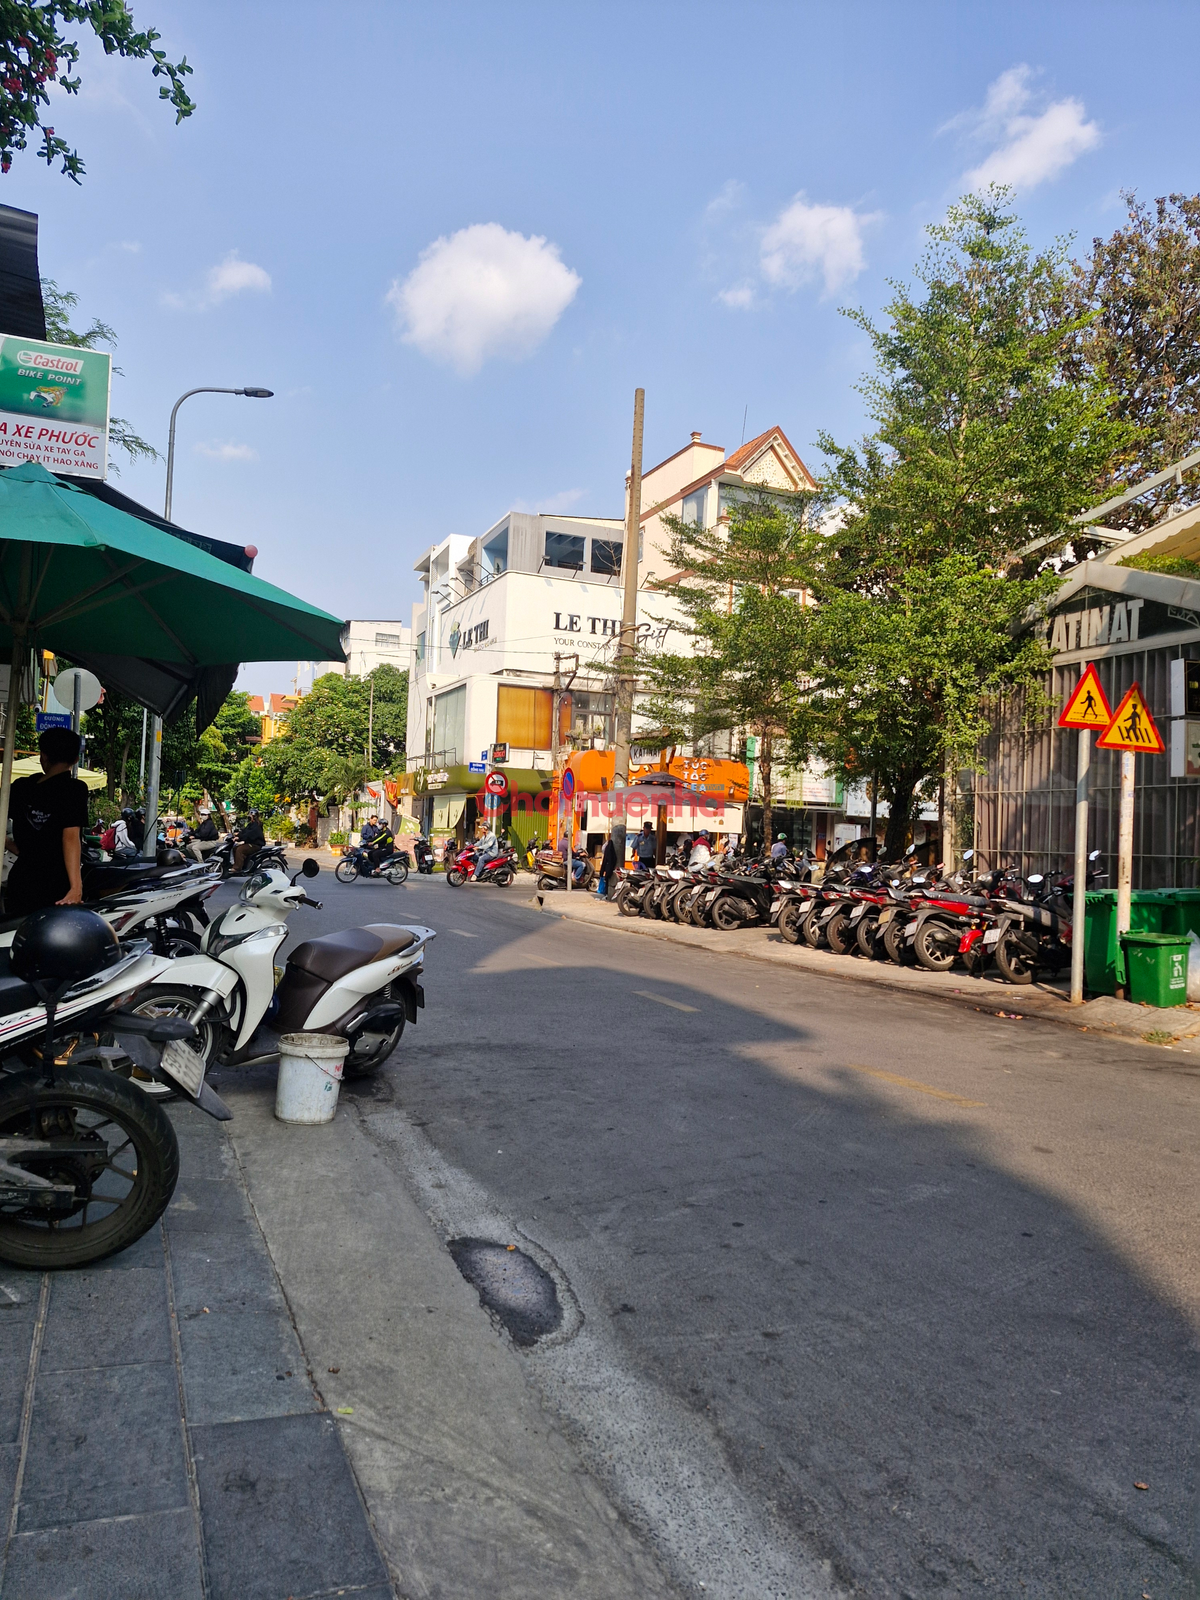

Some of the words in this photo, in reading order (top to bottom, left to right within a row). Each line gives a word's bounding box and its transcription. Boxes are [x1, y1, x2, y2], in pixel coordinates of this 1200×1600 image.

[33, 354, 79, 373] Castrol
[17, 369, 44, 380] BIKE
[47, 374, 82, 386] POINT
[12, 424, 35, 439] XE
[37, 428, 99, 449] PHƯỚC
[24, 441, 41, 451] SỬA
[44, 445, 54, 453] XE
[56, 446, 71, 455] TAY
[53, 457, 72, 466] HAO
[553, 611, 582, 632] LE
[554, 637, 575, 646] YOUR
[637, 622, 671, 649] Gift
